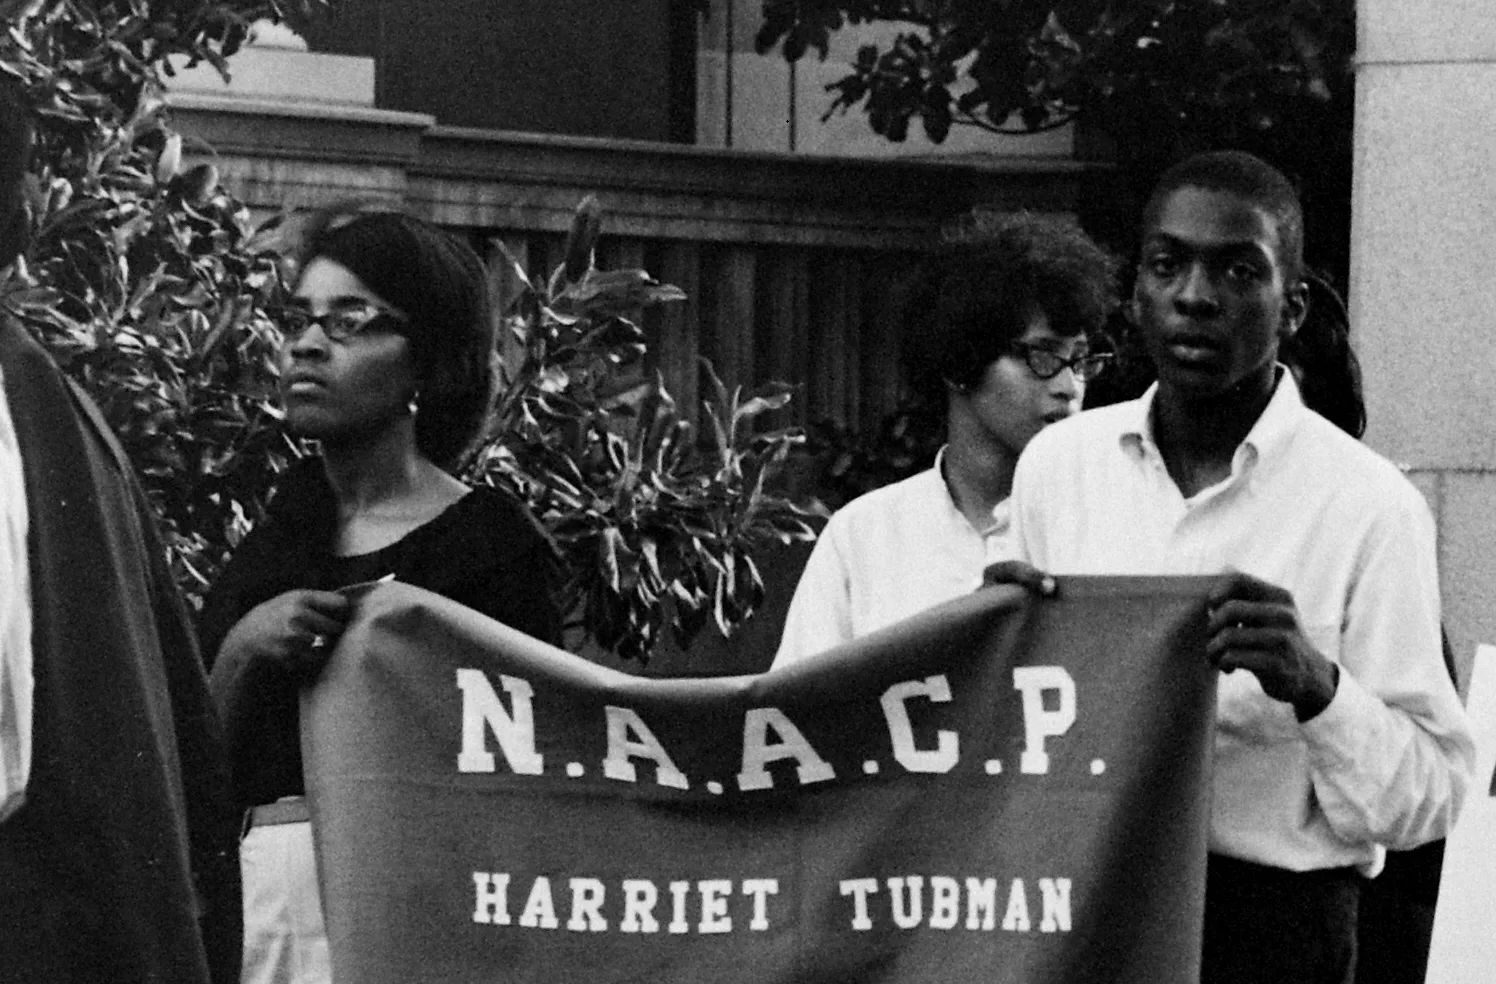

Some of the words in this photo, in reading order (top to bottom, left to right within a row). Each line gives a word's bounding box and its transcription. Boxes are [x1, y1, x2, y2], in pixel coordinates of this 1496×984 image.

[456, 666, 1106, 795] N.A.A.C.P.
[473, 872, 779, 933] HARRIET
[840, 876, 1073, 932] TUBMAN
